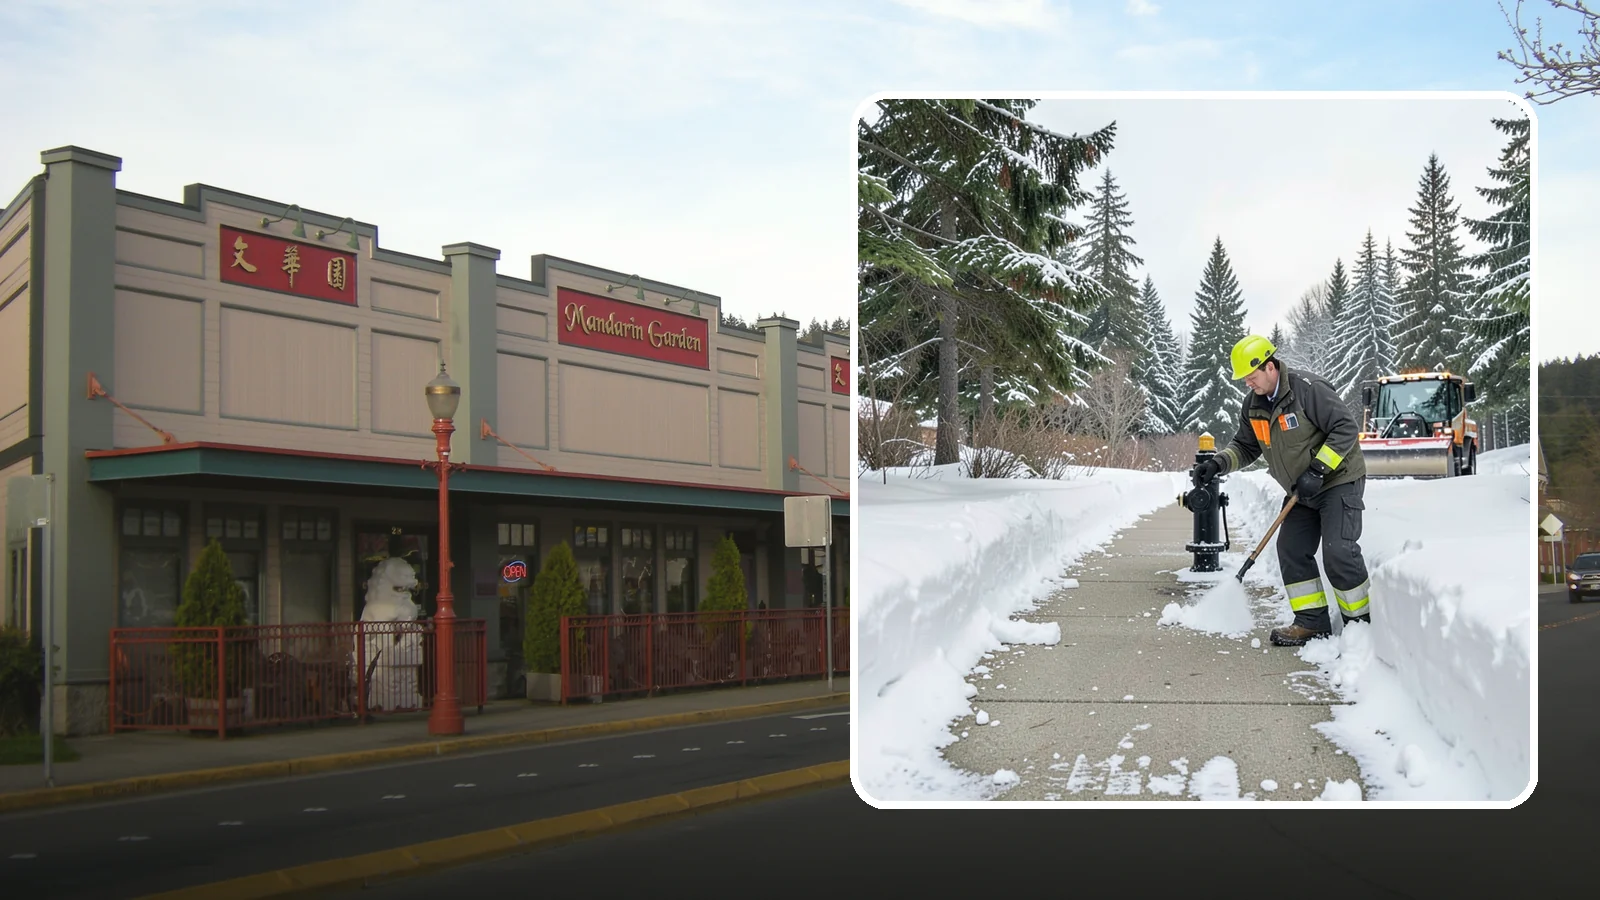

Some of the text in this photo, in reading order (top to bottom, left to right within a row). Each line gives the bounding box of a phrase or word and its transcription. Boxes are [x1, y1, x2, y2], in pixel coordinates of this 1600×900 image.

[231, 235, 346, 291] 文華園
[565, 302, 702, 352] Mandarin Garden
[503, 565, 527, 578] OPEN
